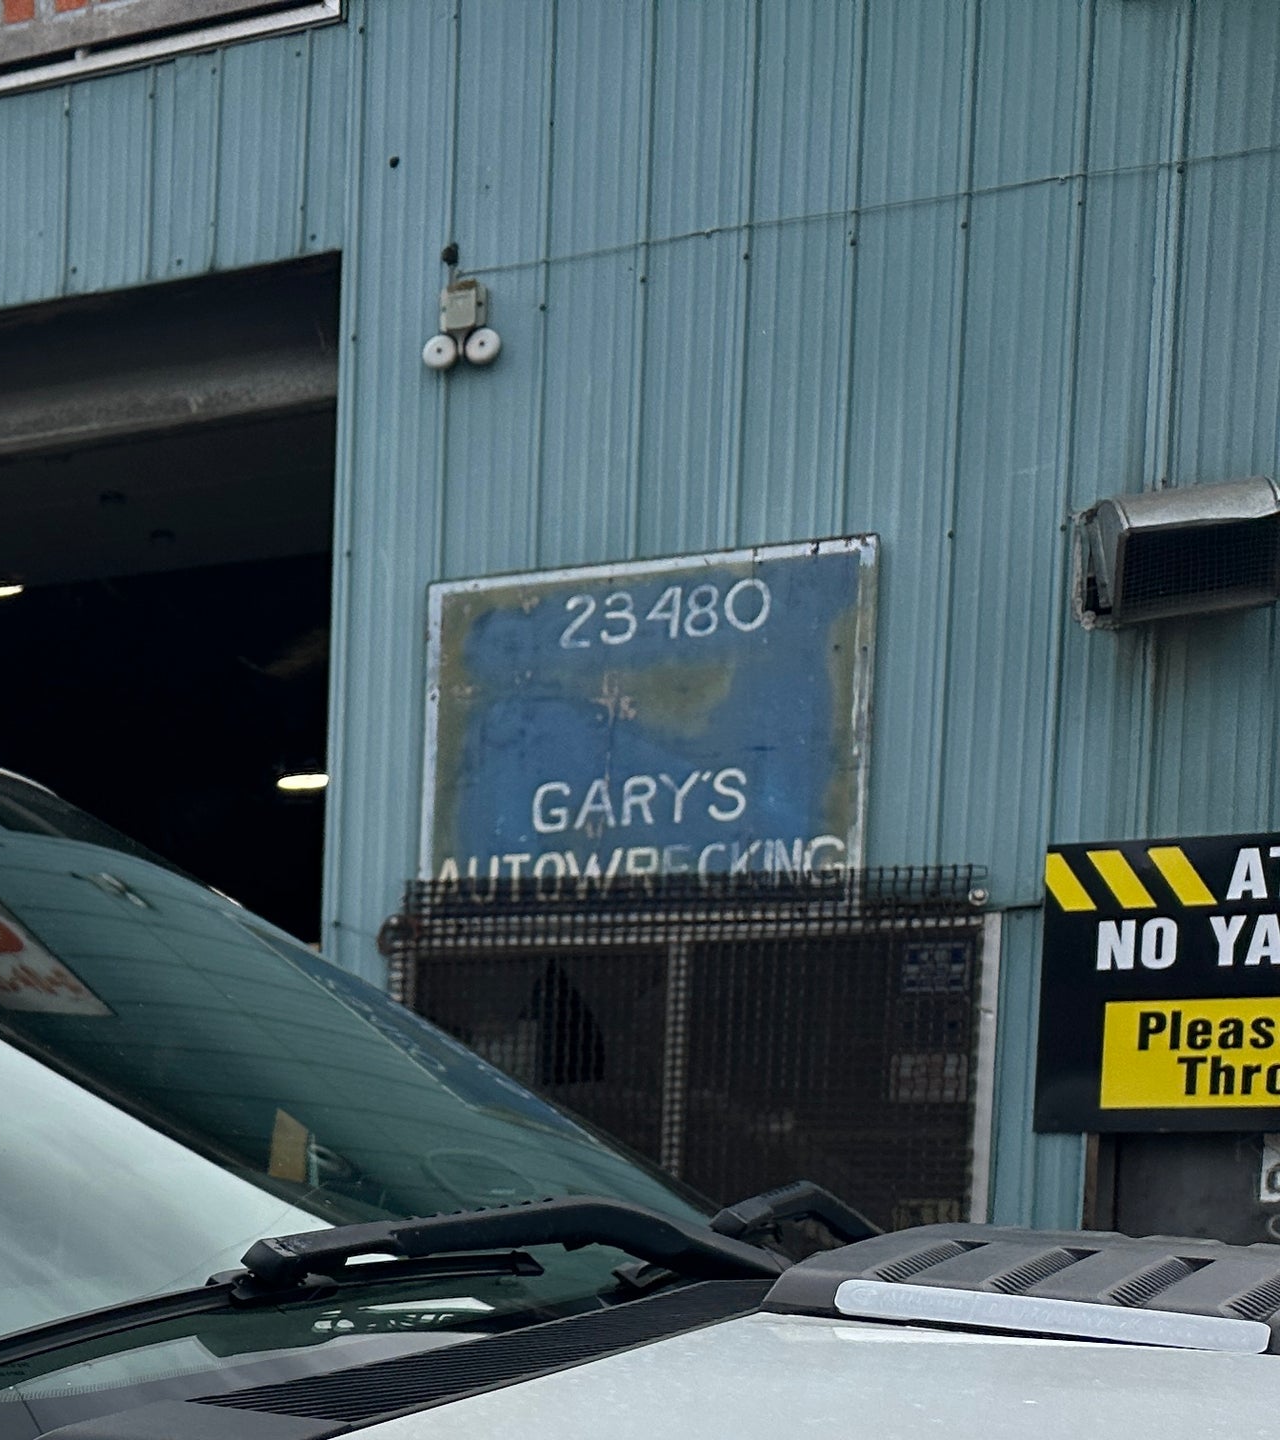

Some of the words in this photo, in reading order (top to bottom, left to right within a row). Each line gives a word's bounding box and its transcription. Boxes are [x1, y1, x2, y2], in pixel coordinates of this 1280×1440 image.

[560, 577, 771, 649] 23480
[532, 767, 747, 834] GARY'S
[1096, 916, 1178, 971] NO
[1209, 913, 1280, 967] YA
[1137, 1009, 1276, 1051] Pleas
